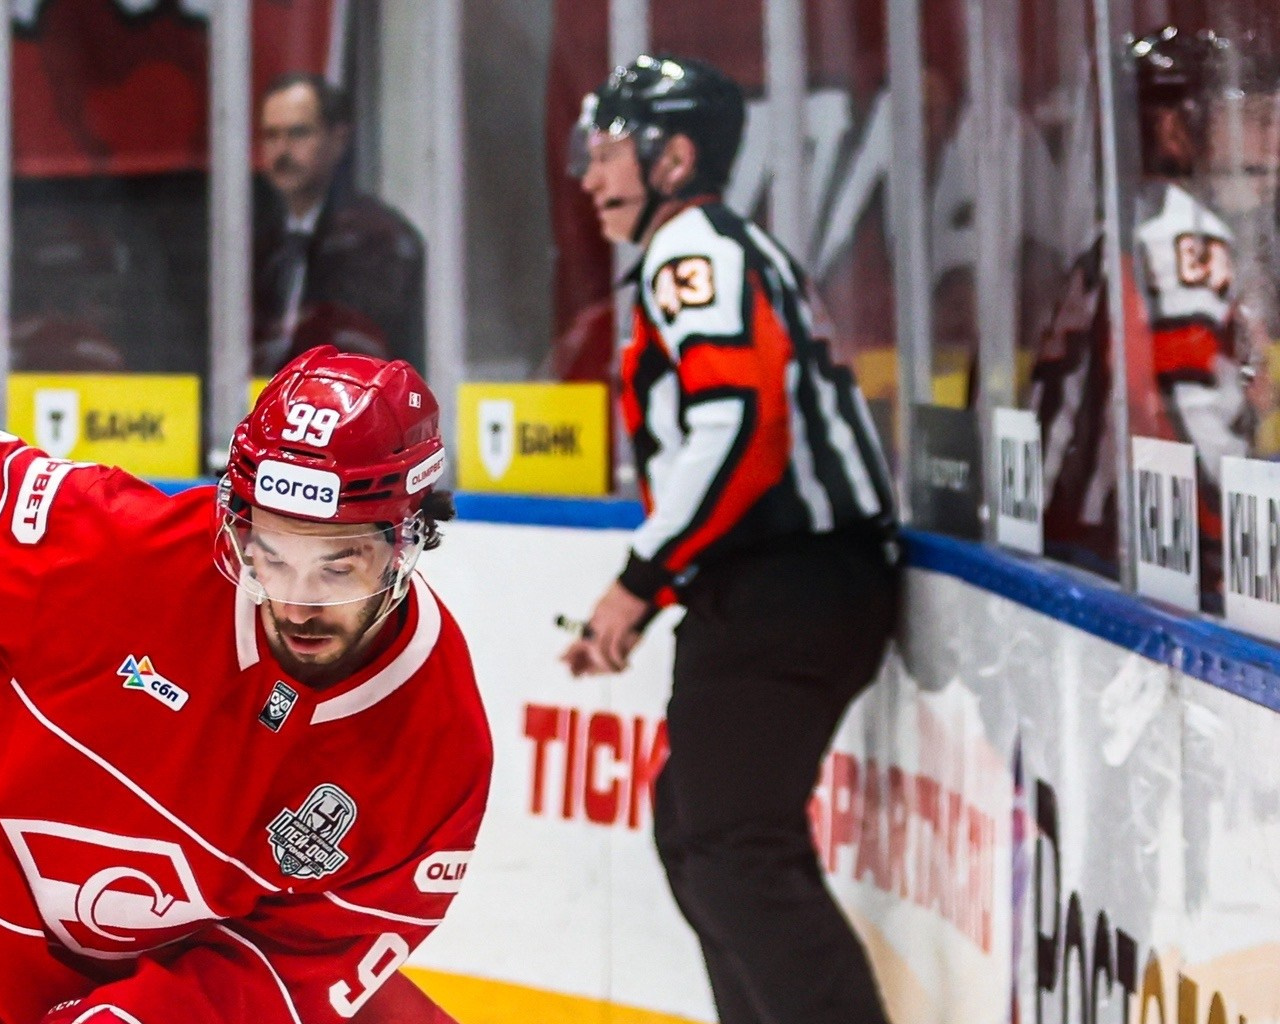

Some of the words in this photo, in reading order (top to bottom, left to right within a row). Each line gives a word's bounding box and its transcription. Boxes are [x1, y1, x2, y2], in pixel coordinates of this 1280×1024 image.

[281, 402, 340, 447] 99
[23, 461, 69, 530] PBET
[259, 473, 335, 504] согаз
[150, 679, 180, 704] сбп
